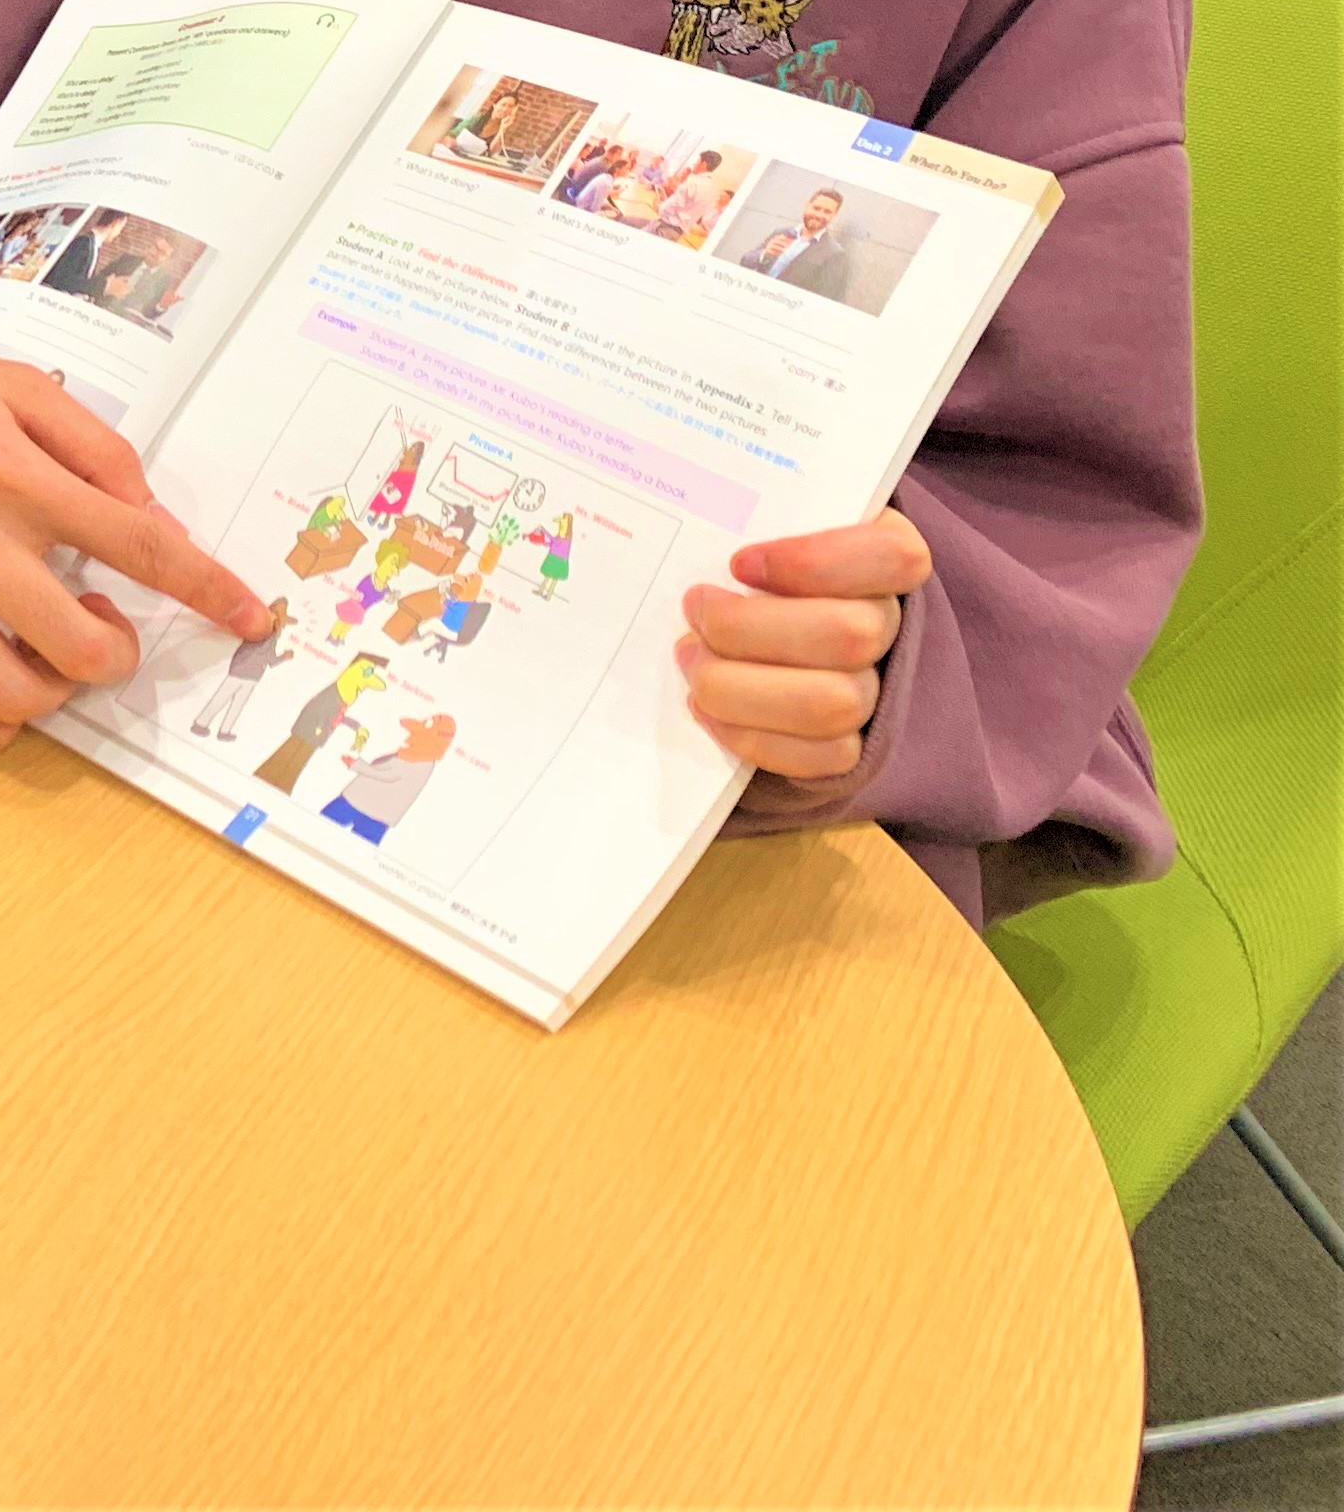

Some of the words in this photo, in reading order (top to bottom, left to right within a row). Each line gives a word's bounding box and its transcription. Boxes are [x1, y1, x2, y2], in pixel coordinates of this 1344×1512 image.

[856, 137, 881, 154] Unit
[882, 145, 894, 156] 2
[910, 155, 941, 174] What
[942, 166, 959, 179] Do
[960, 170, 981, 186] You
[355, 223, 399, 247] Practice
[336, 235, 374, 257] Student
[514, 303, 559, 327] Student
[574, 327, 599, 347] Look
[602, 339, 615, 350] at
[617, 343, 636, 359] the
[637, 353, 678, 378] picture
[681, 369, 692, 383] in
[694, 378, 753, 410] Appendix
[772, 408, 792, 426] Tell
[793, 421, 823, 439] your
[564, 342, 622, 374] differences
[623, 366, 672, 397] between
[674, 386, 693, 403] the
[696, 398, 718, 416] two
[547, 405, 591, 435] reading
[467, 432, 504, 459] Picture
[555, 432, 595, 460] Kubo's
[596, 446, 642, 482] reading
